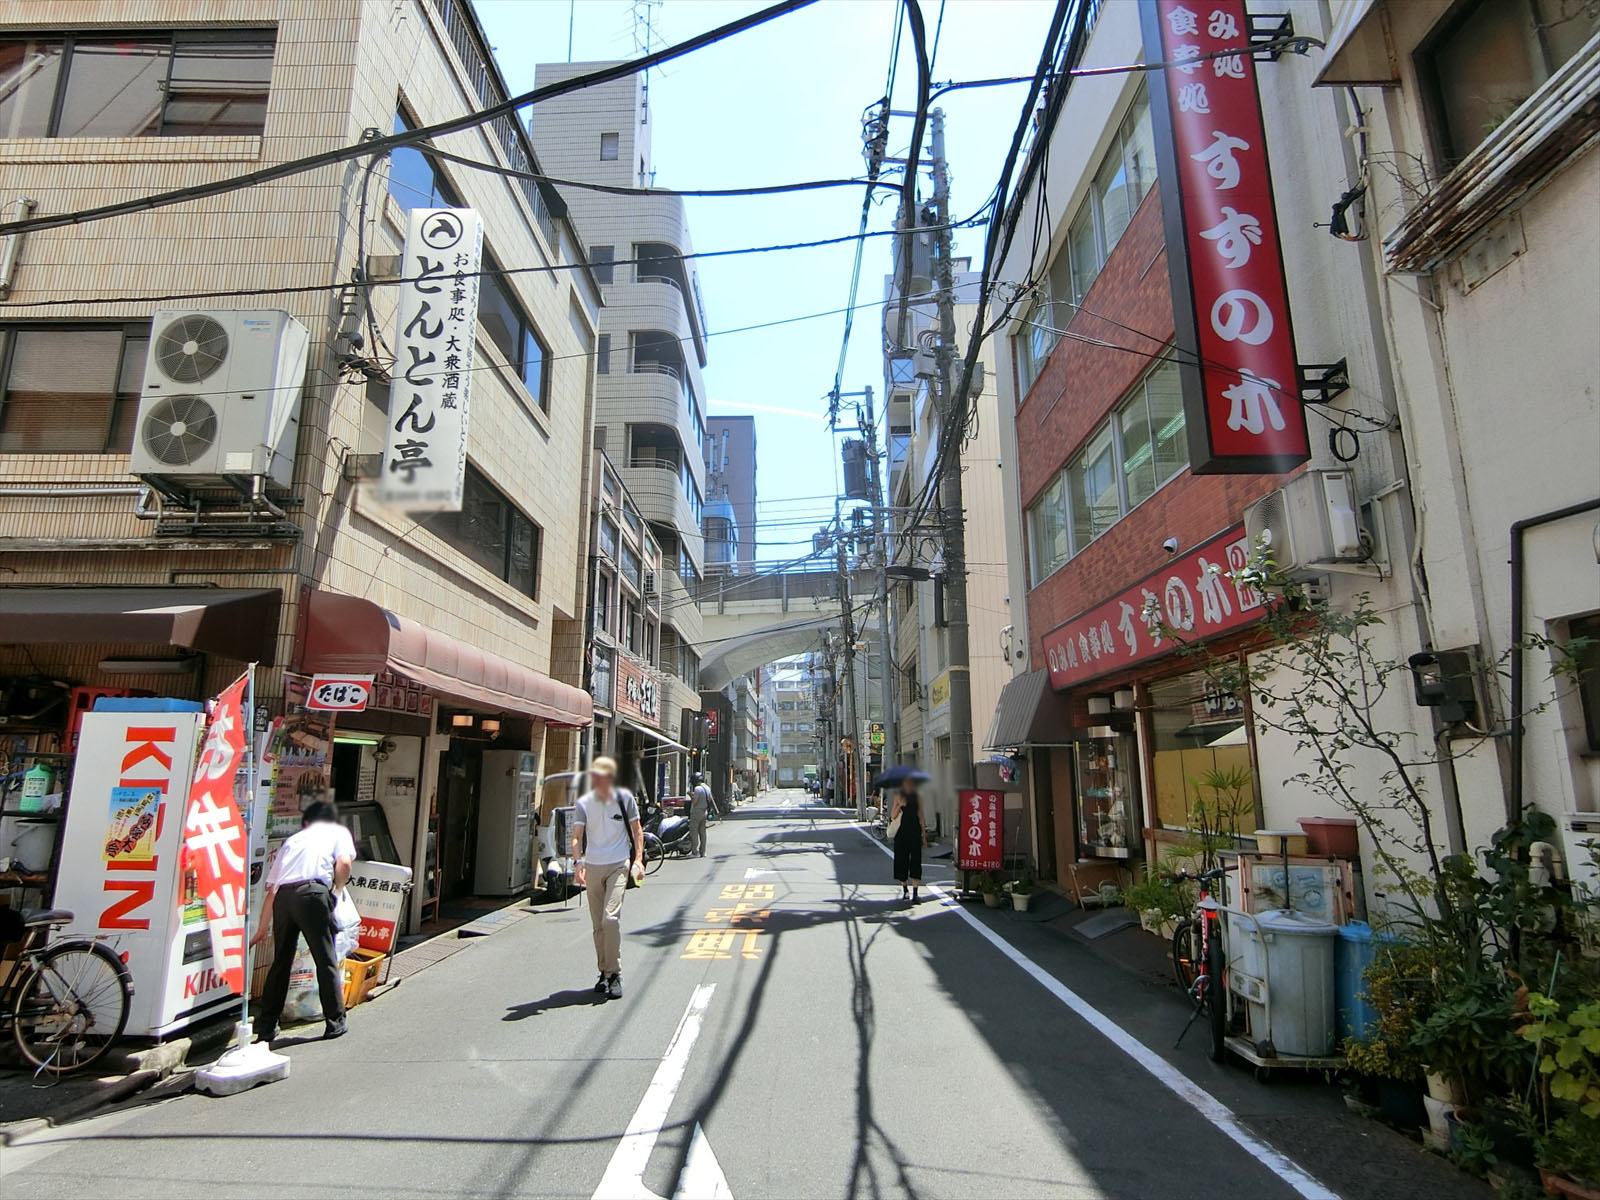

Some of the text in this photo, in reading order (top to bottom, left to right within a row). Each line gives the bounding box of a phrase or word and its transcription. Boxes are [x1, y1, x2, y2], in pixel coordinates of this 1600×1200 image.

[1190, 130, 1286, 436] すずのか
[389, 255, 445, 484] とんとん亭
[318, 684, 361, 703] たばこ
[186, 704, 245, 972] お弁当
[345, 875, 401, 893] 大衆居酒屋
[968, 794, 982, 857] すずのか
